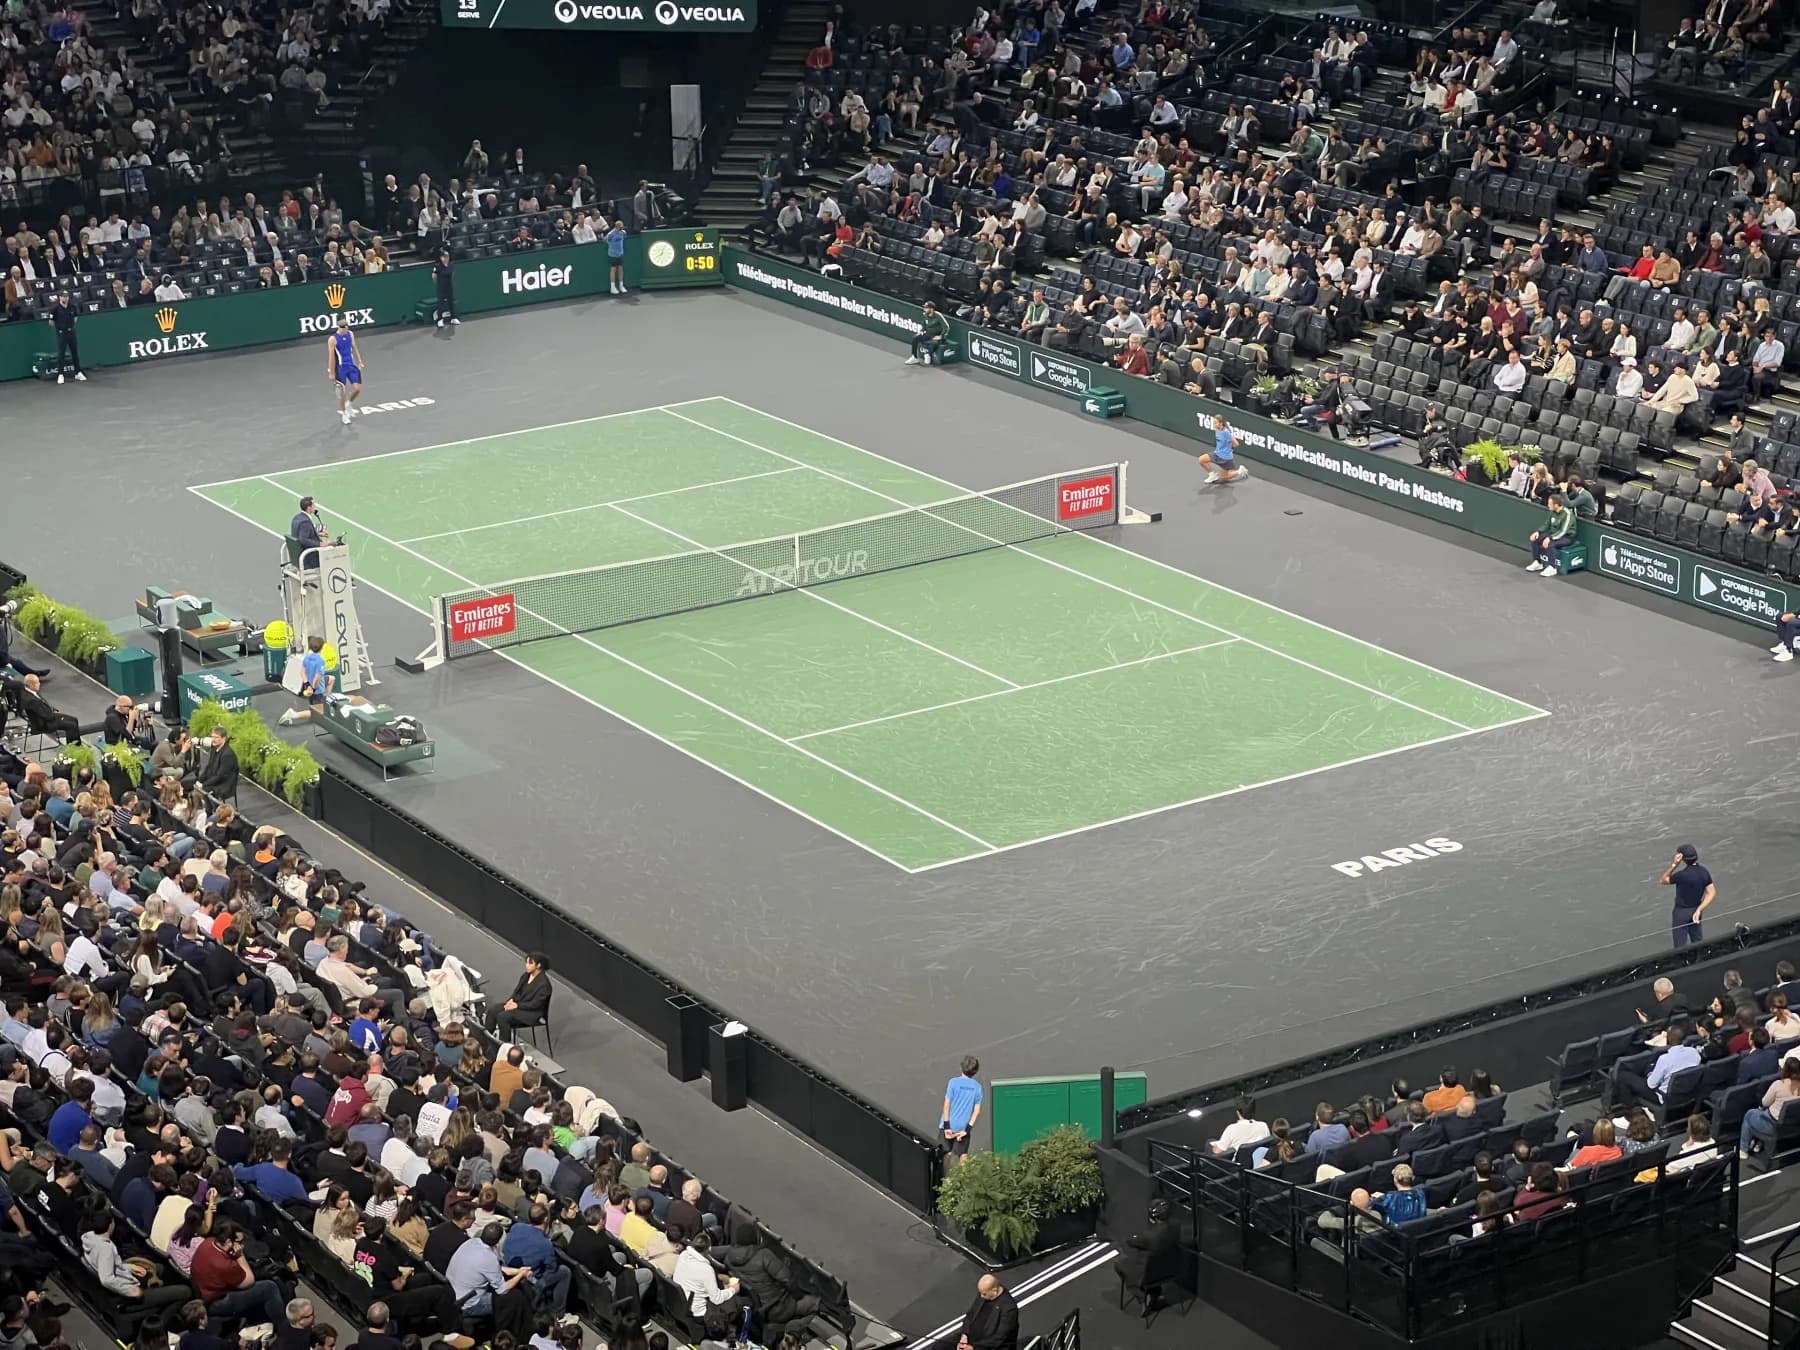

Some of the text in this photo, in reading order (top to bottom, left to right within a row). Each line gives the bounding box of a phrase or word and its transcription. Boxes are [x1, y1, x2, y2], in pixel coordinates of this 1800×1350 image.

[580, 5, 644, 20] VEOLIA
[680, 7, 745, 21] VEOLIA
[685, 242, 715, 251] ROLEX
[686, 255, 714, 271] 0:50
[502, 263, 573, 294] Haier
[737, 262, 787, 289] Téléchargez
[840, 297, 866, 316] Rolex
[866, 305, 890, 323] Paris
[890, 312, 925, 335] Master
[299, 308, 376, 334] ROLEX
[128, 332, 209, 358] ROLEX
[999, 353, 1018, 369] Store
[1048, 369, 1087, 392] Google Play
[1196, 412, 1266, 447] Télhargez
[1341, 460, 1377, 485] Rolex
[1378, 472, 1411, 496] Paris
[1411, 484, 1464, 513] Masters
[1062, 483, 1111, 502] Emirates
[1069, 496, 1104, 513] FLY BETTER
[800, 549, 869, 584] TOUR
[1619, 556, 1675, 585] l'App Store
[454, 602, 512, 624] Emirates
[1720, 588, 1780, 621] Google Play
[463, 615, 504, 634] FLY BETTER
[334, 599, 351, 676] LEXUS
[1330, 837, 1464, 878] PARIS
